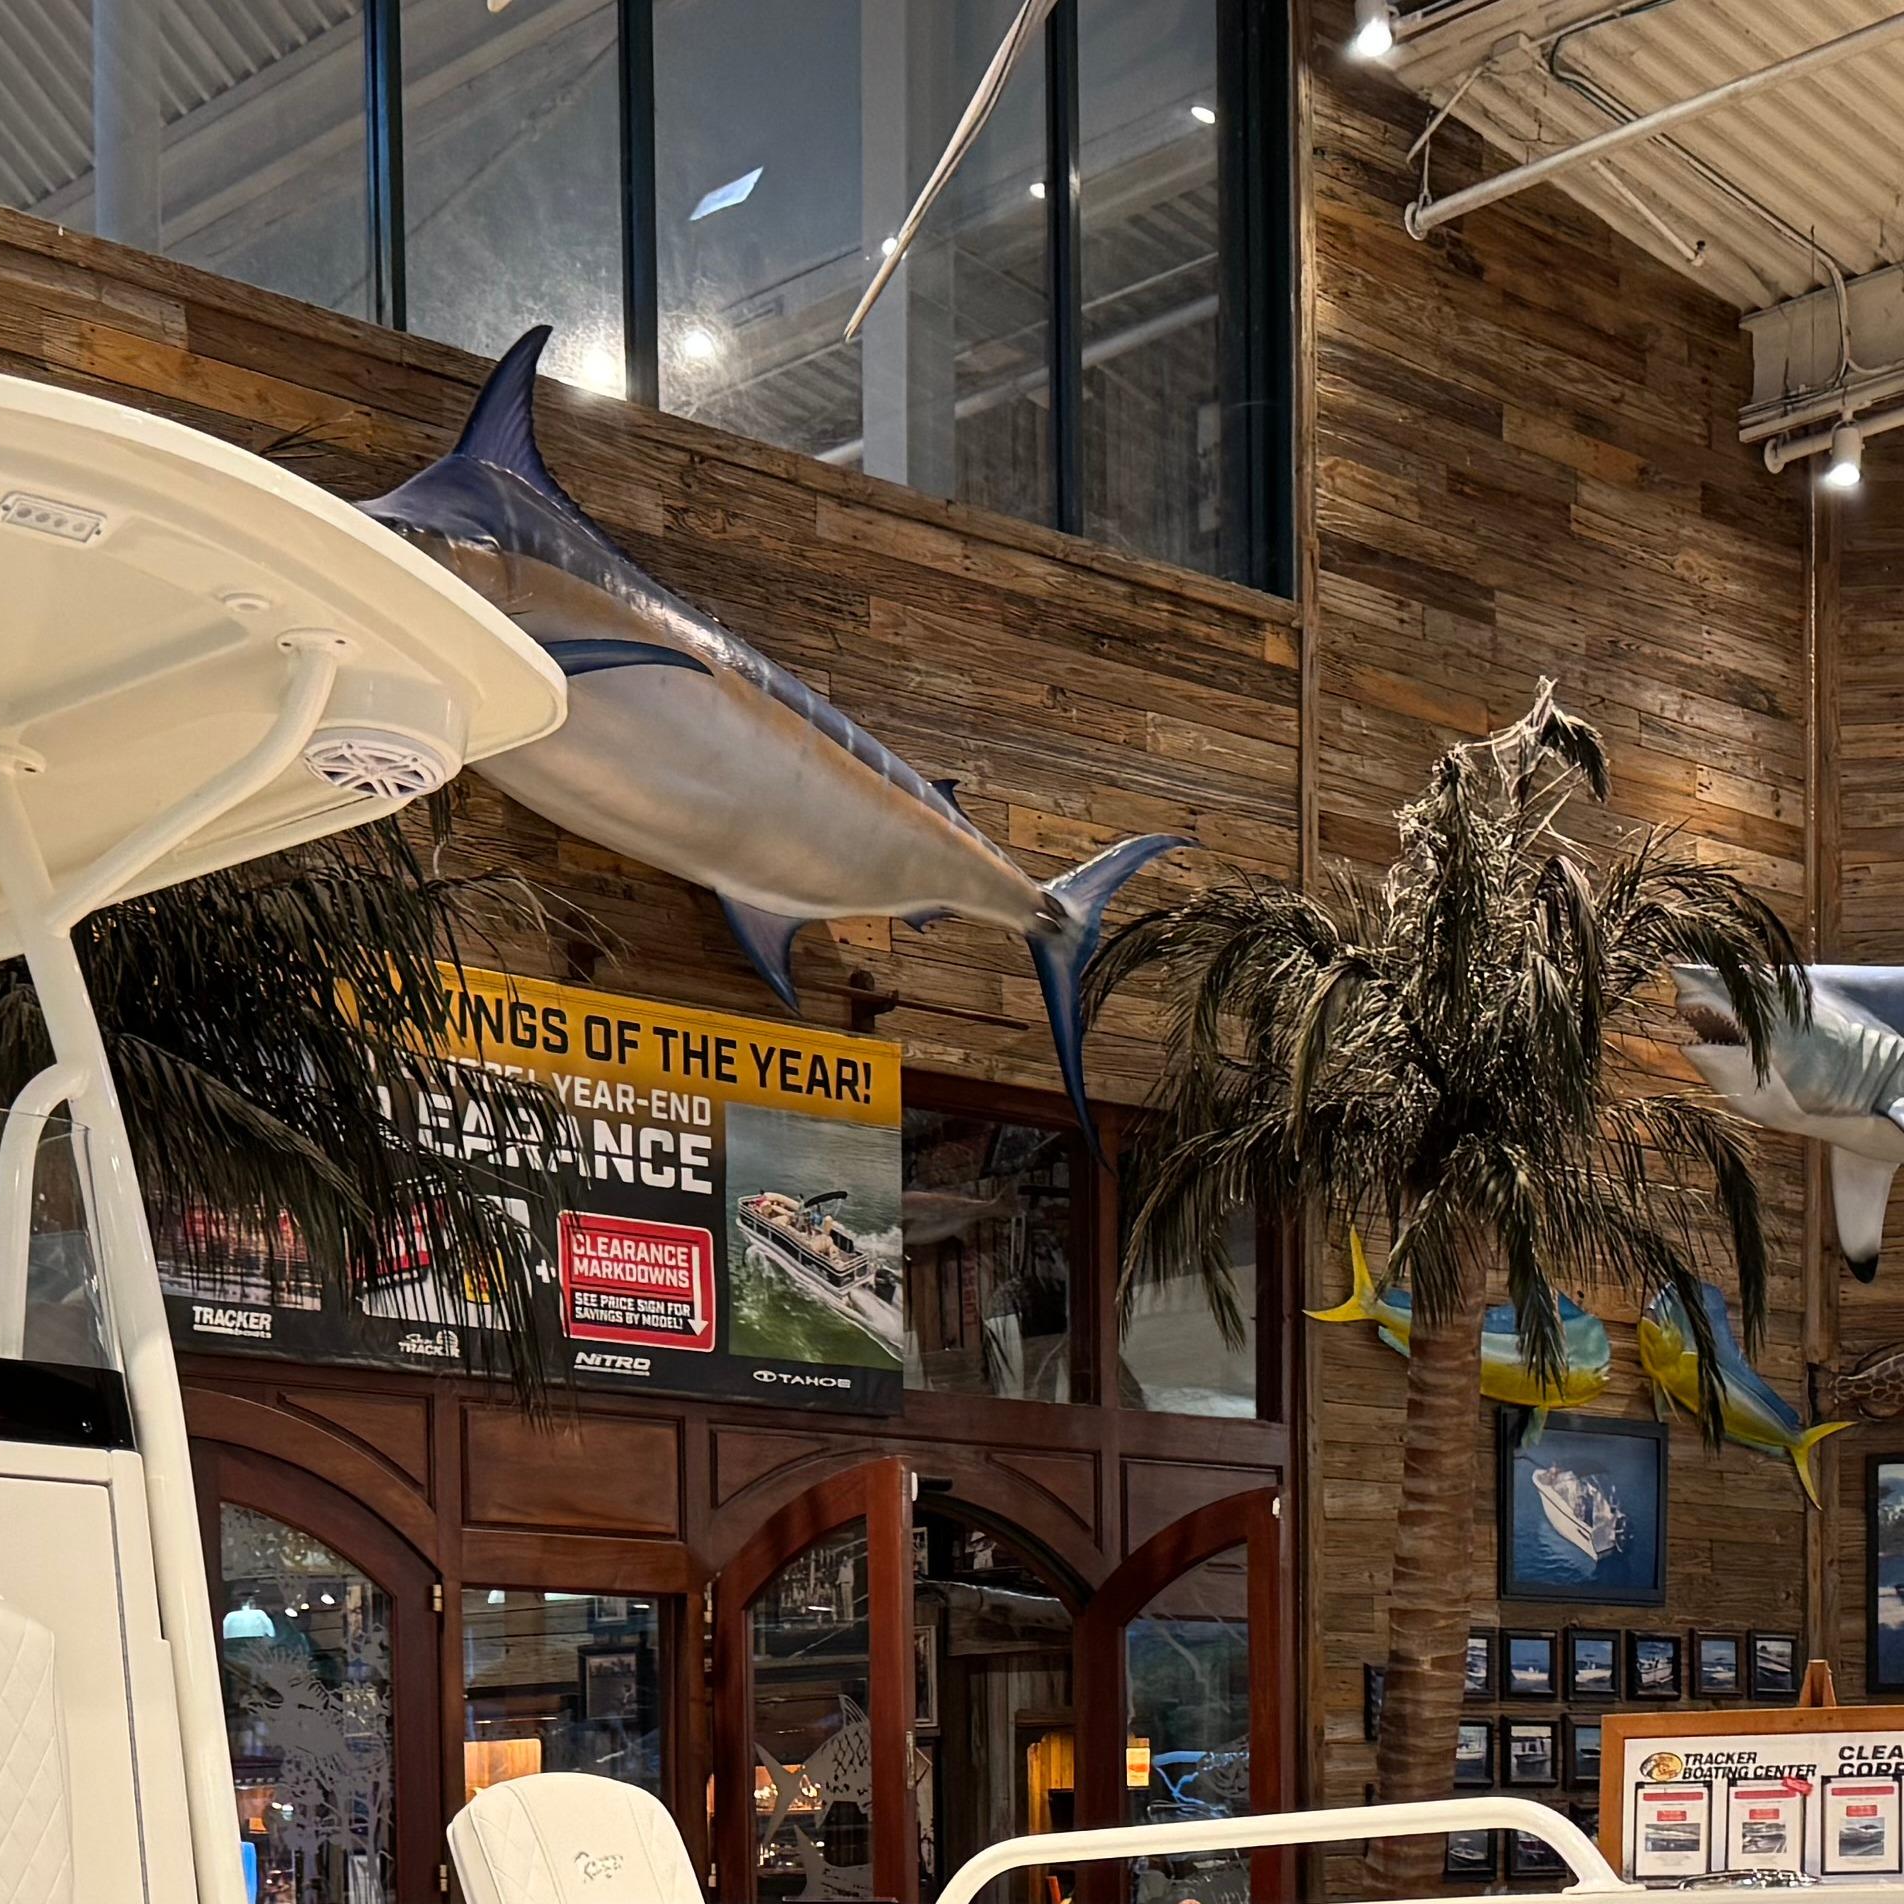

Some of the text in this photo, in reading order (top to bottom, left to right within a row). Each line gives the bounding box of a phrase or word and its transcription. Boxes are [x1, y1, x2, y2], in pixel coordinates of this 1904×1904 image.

[585, 1015, 641, 1064] OF
[653, 1026, 738, 1084] THE
[750, 1043, 872, 1104] YEAR!
[552, 1072, 712, 1127] YEAR-END
[372, 1084, 713, 1195] LEARANCE
[573, 1233, 689, 1268] CLEARANCE
[573, 1257, 690, 1289] MARKDOWNS
[193, 1306, 273, 1330] TRACKER
[575, 1292, 691, 1318] SEE PRICE SIGN FOR
[575, 1306, 684, 1330] SAVINGS BY MODEL!
[778, 1373, 852, 1389] TAHOE
[1682, 1766, 1749, 1779] BOATING
[1753, 1764, 1817, 1779] CENTER
[1683, 1752, 1757, 1766] TRACKER
